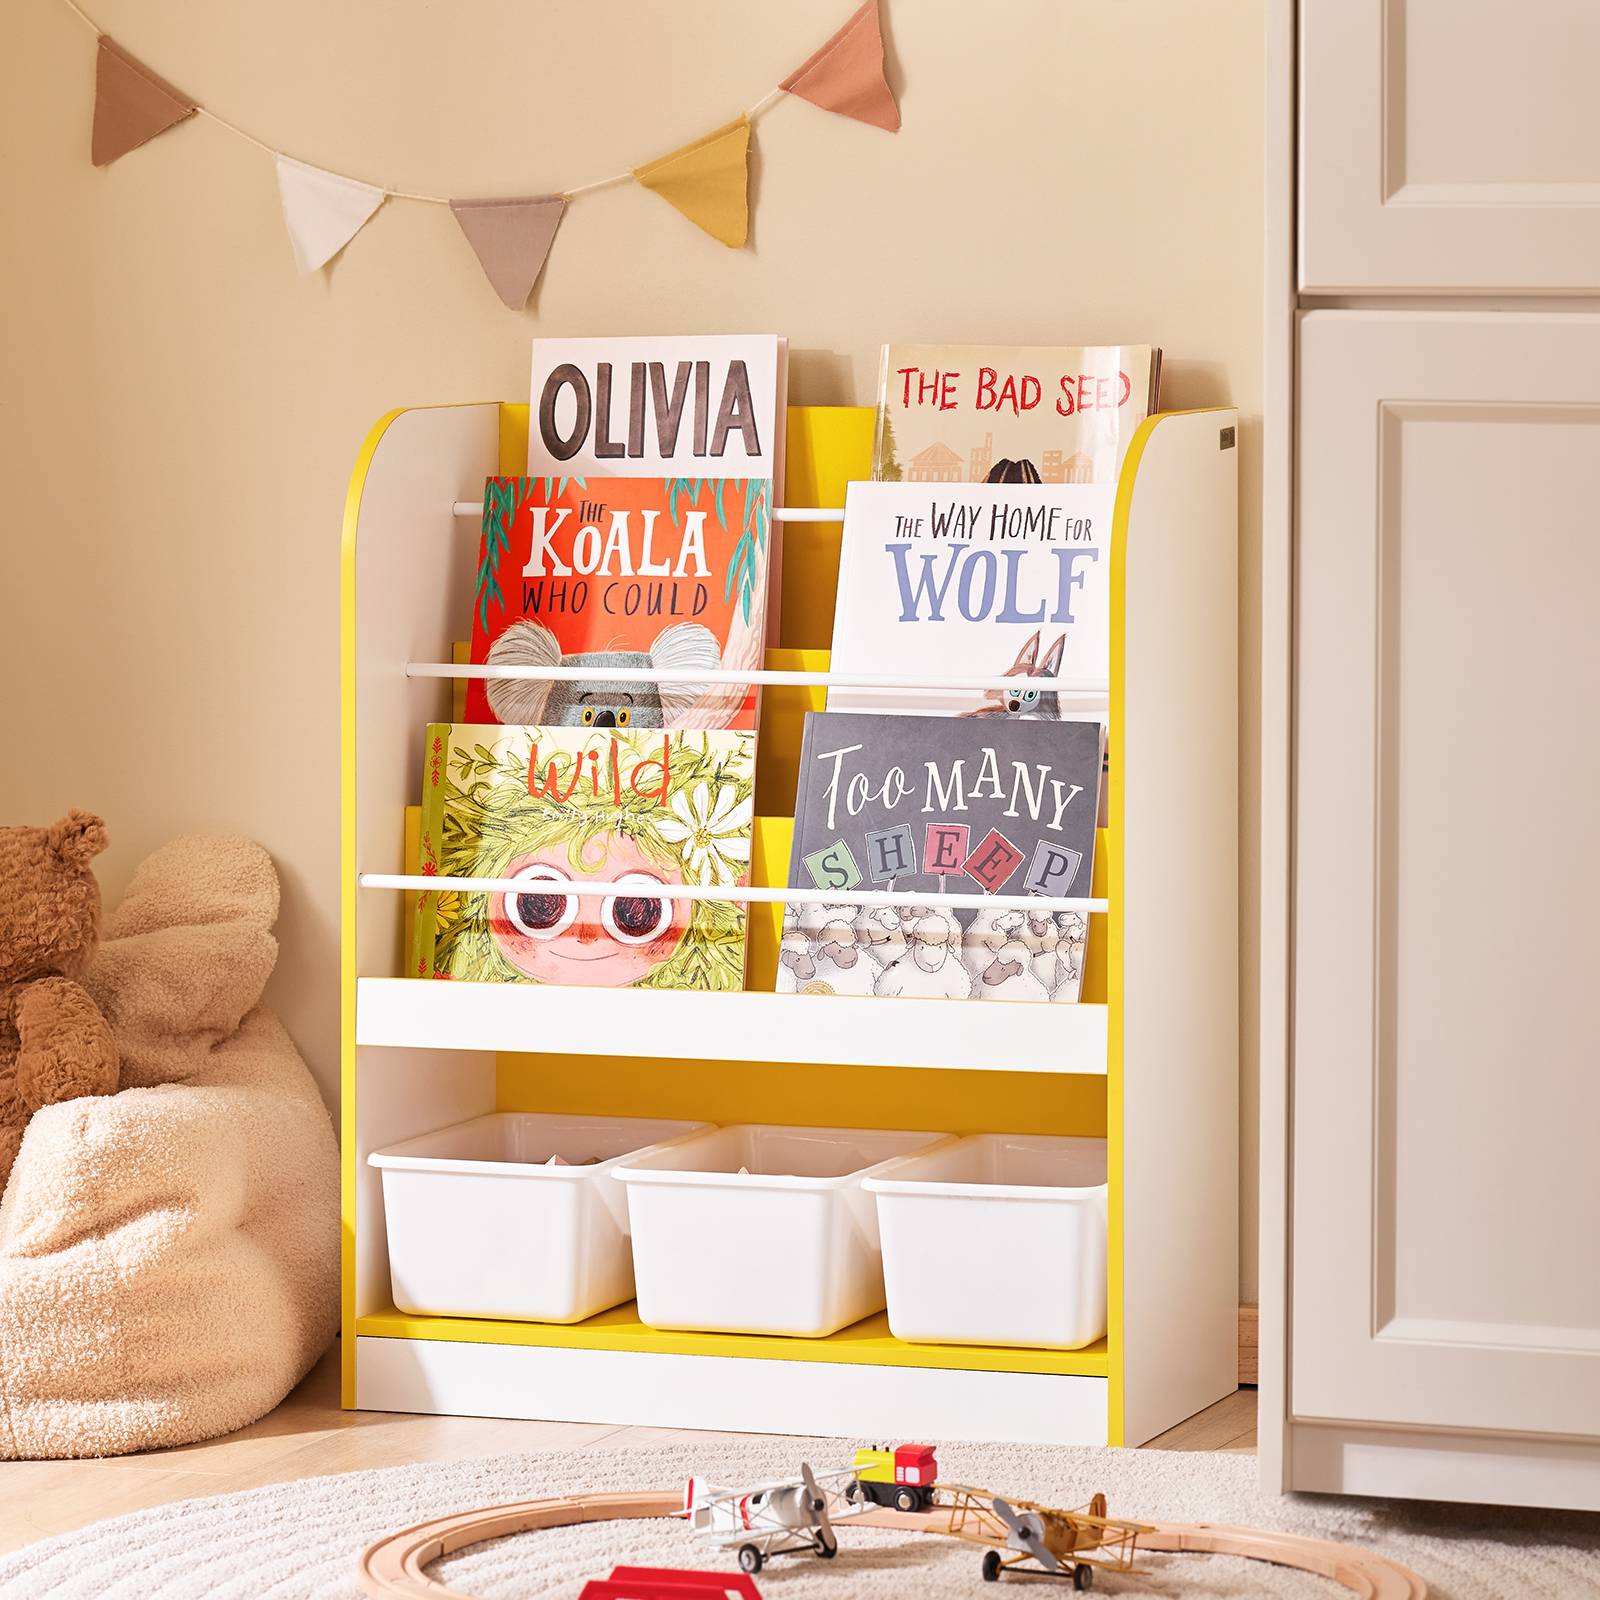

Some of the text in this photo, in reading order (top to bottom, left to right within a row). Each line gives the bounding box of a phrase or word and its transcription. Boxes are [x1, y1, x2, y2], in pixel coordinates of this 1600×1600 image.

[539, 360, 762, 461] OLIVIA
[896, 367, 1131, 418] THE BAD SEED
[579, 500, 607, 523] THE
[895, 502, 1092, 541] THE WAY HOME FOR
[522, 507, 713, 577] KOALA
[523, 581, 708, 616] WHO COULD
[885, 543, 1099, 624] WOLF
[921, 748, 1083, 830] MANY
[821, 831, 1068, 890] SHEEP
